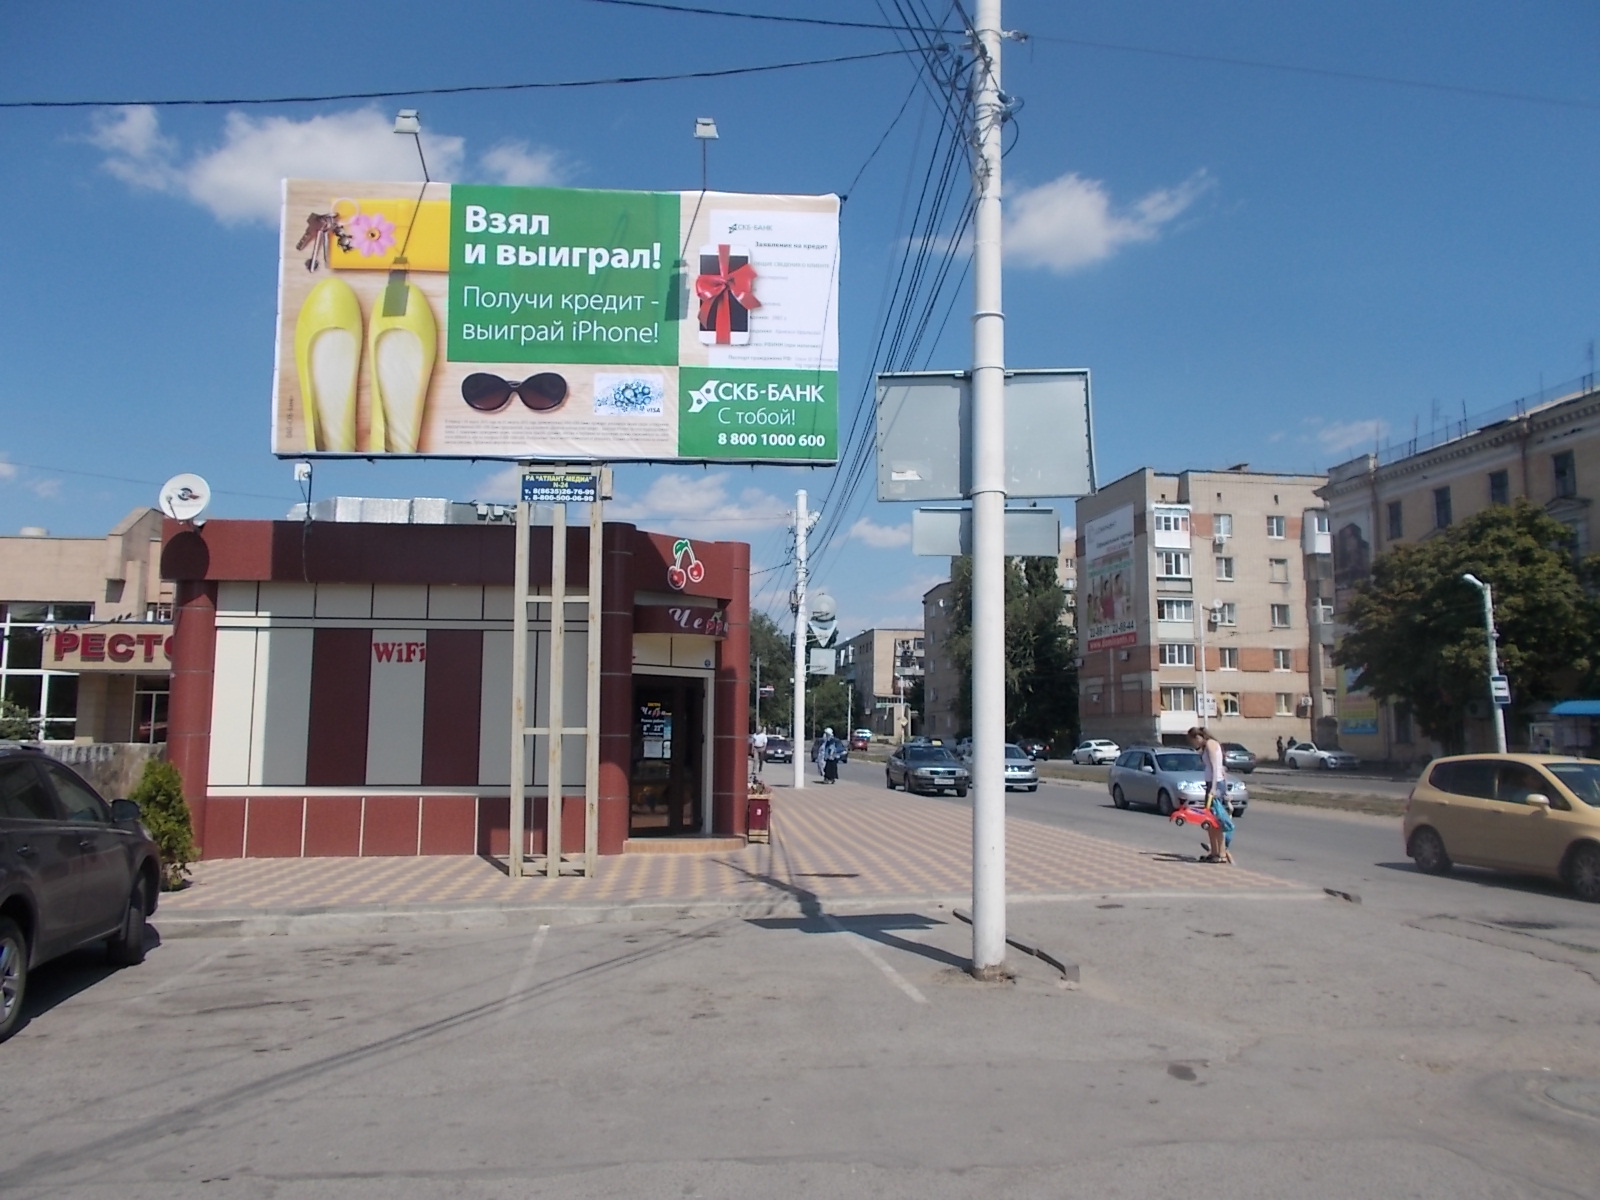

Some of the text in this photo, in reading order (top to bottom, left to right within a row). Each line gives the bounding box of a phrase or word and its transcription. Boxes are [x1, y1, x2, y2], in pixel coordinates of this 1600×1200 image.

[465, 205, 549, 235] Взял
[464, 242, 661, 275] и выиграл!
[463, 286, 553, 314] Получи
[561, 293, 645, 315] кредит
[462, 321, 659, 346] выиграй iPhone!
[718, 383, 825, 402] СКБ-БАНК
[718, 407, 796, 425] С тобой!
[718, 433, 825, 447] 8 800 1000 600
[373, 642, 426, 663] WiFi
